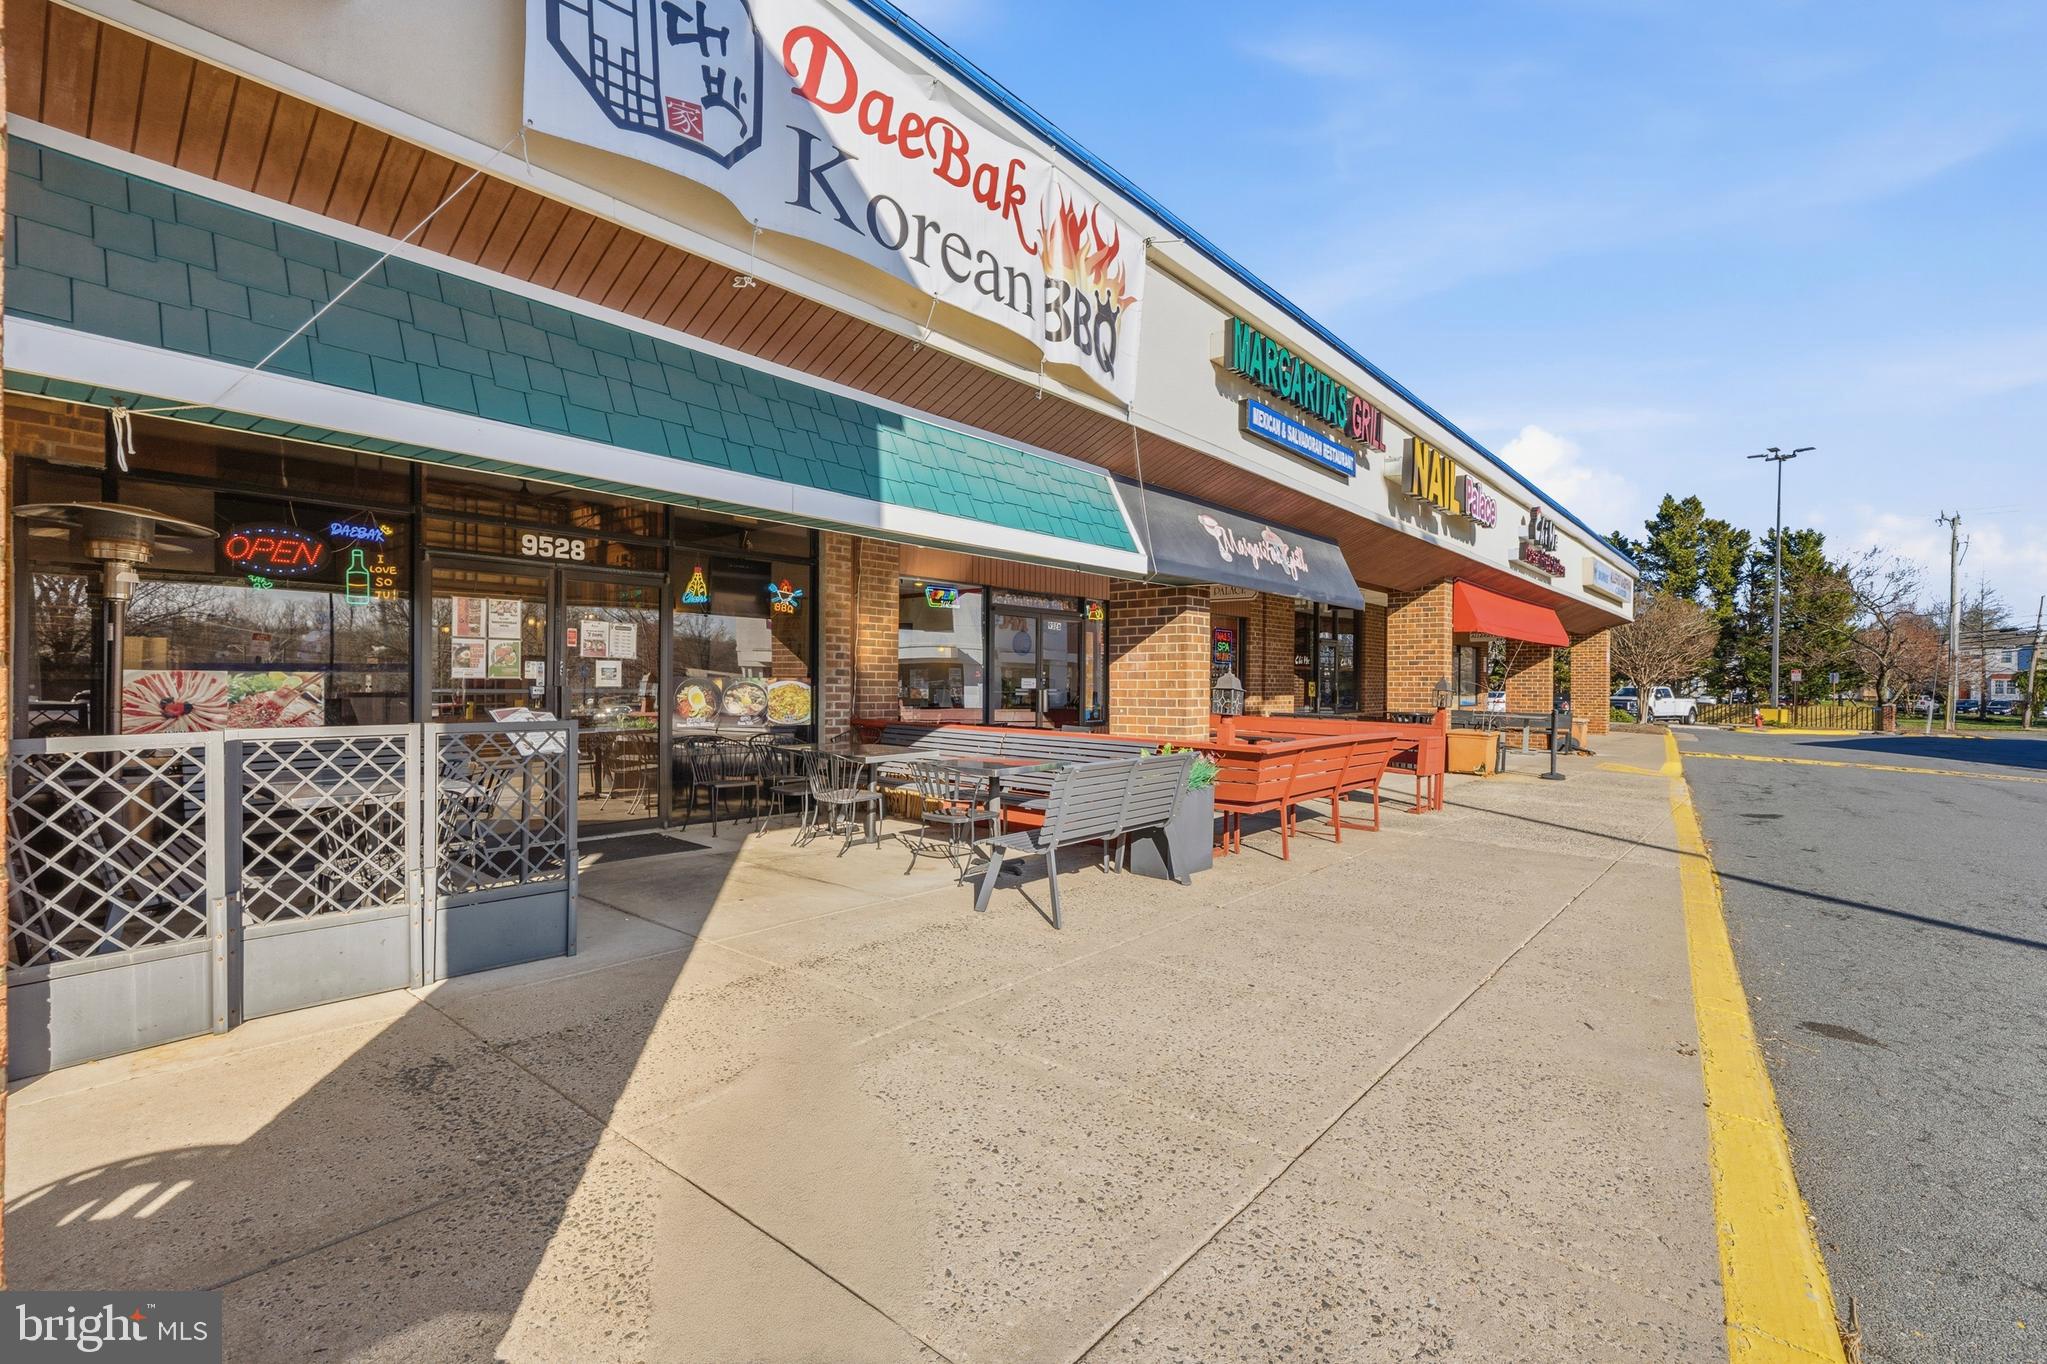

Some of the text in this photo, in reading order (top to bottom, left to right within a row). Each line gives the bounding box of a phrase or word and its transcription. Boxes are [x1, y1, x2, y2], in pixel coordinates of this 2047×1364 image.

[667, 100, 703, 135] 家
[782, 25, 1039, 257] DaeBak
[784, 124, 1120, 381] Korean BBQ
[1234, 317, 1386, 452] MARGARITAS GRILL
[1252, 407, 1281, 437] MEXICAN
[1412, 436, 1460, 515] NAIL
[1464, 475, 1497, 529] Palace
[223, 533, 323, 567] OPEN
[521, 534, 586, 561] 9528
[369, 565, 398, 575] LOVE
[375, 577, 393, 587] SO
[774, 602, 794, 614] BBQ
[1217, 641, 1231, 652] SPA
